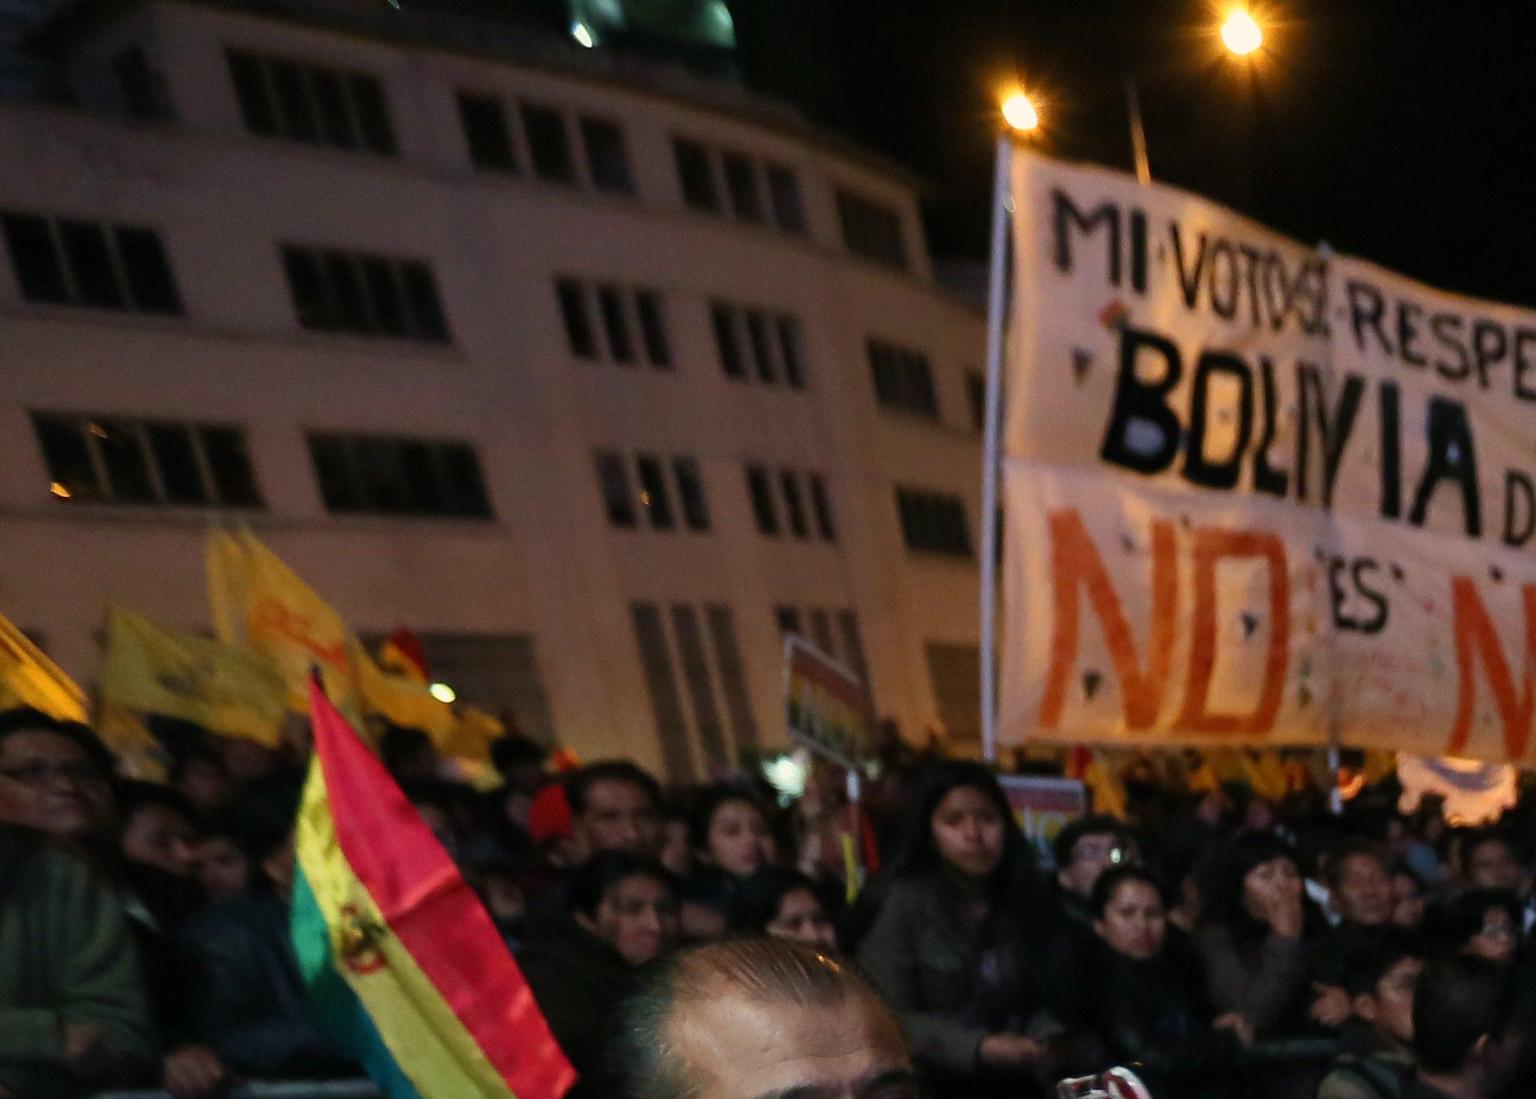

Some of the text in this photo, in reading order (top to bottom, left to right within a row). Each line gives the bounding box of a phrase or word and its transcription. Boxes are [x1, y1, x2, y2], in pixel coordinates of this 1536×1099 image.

[1050, 187, 1147, 294] MI
[1168, 221, 1290, 332] VOTO
[1100, 322, 1482, 539] BOLIVIA
[1039, 507, 1291, 733] NO
[1329, 556, 1389, 635] ES
